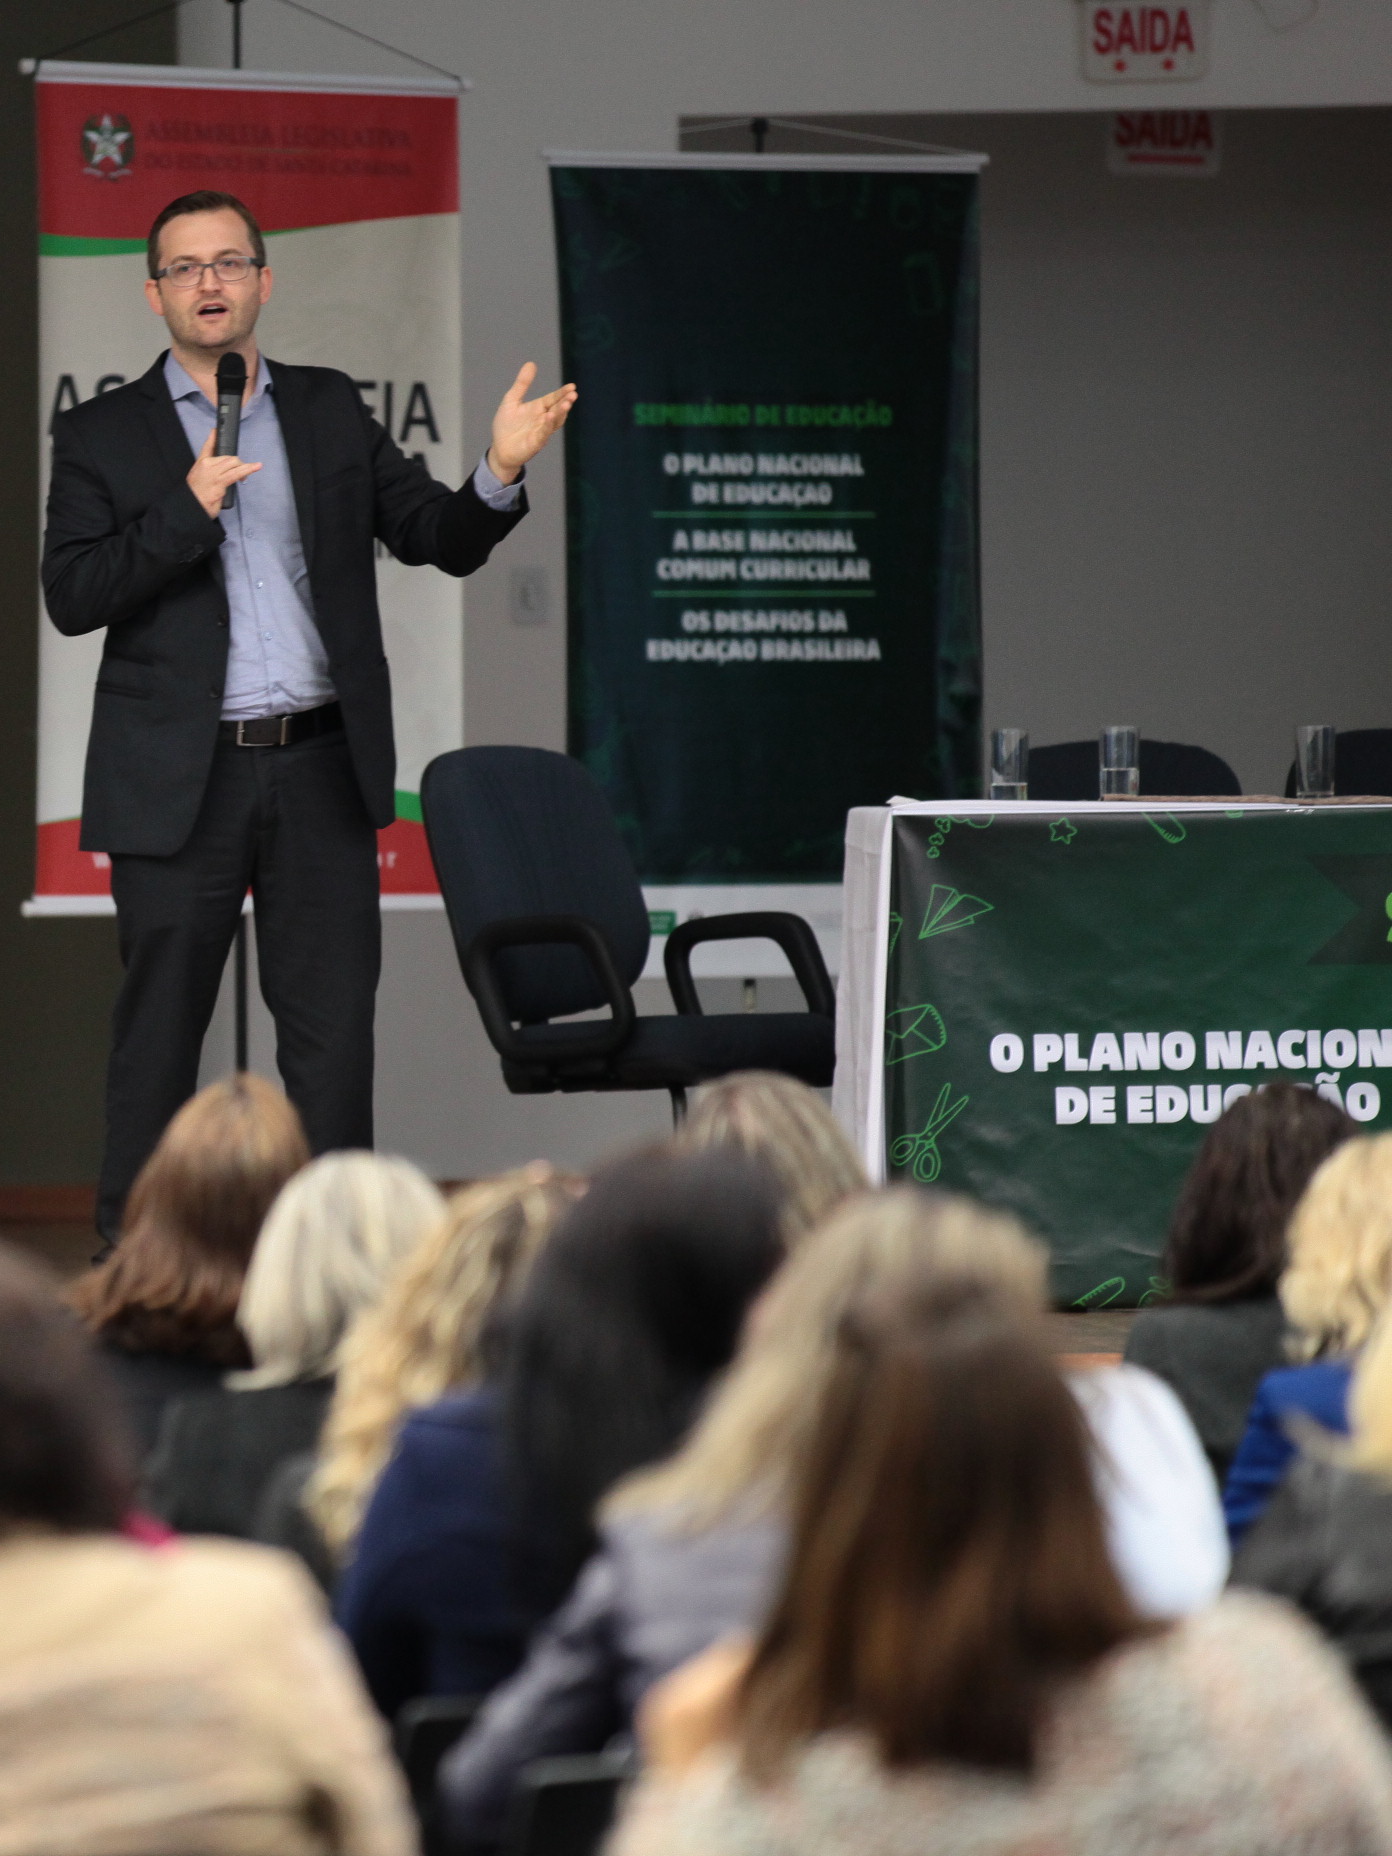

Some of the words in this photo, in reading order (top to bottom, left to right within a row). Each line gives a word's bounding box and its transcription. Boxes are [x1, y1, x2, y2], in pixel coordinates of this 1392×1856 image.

[755, 403, 781, 426] DE
[663, 453, 679, 476] O
[682, 453, 753, 476] PLANO
[757, 453, 864, 476] NACIONAL
[691, 482, 719, 505] DE
[672, 529, 689, 553] A
[692, 529, 745, 553] BASE
[749, 529, 857, 553] NACIONAL
[656, 558, 737, 581] COMUM
[739, 558, 871, 581] CURRICULAR
[680, 609, 711, 633] OS
[713, 609, 815, 633] DESAFIOS
[817, 609, 848, 633] DA
[760, 638, 882, 662] BRASILEIRA
[990, 1032, 1024, 1073] O
[1033, 1031, 1196, 1072] PLANO
[1205, 1029, 1392, 1070] NACION
[1055, 1085, 1116, 1125] DE
